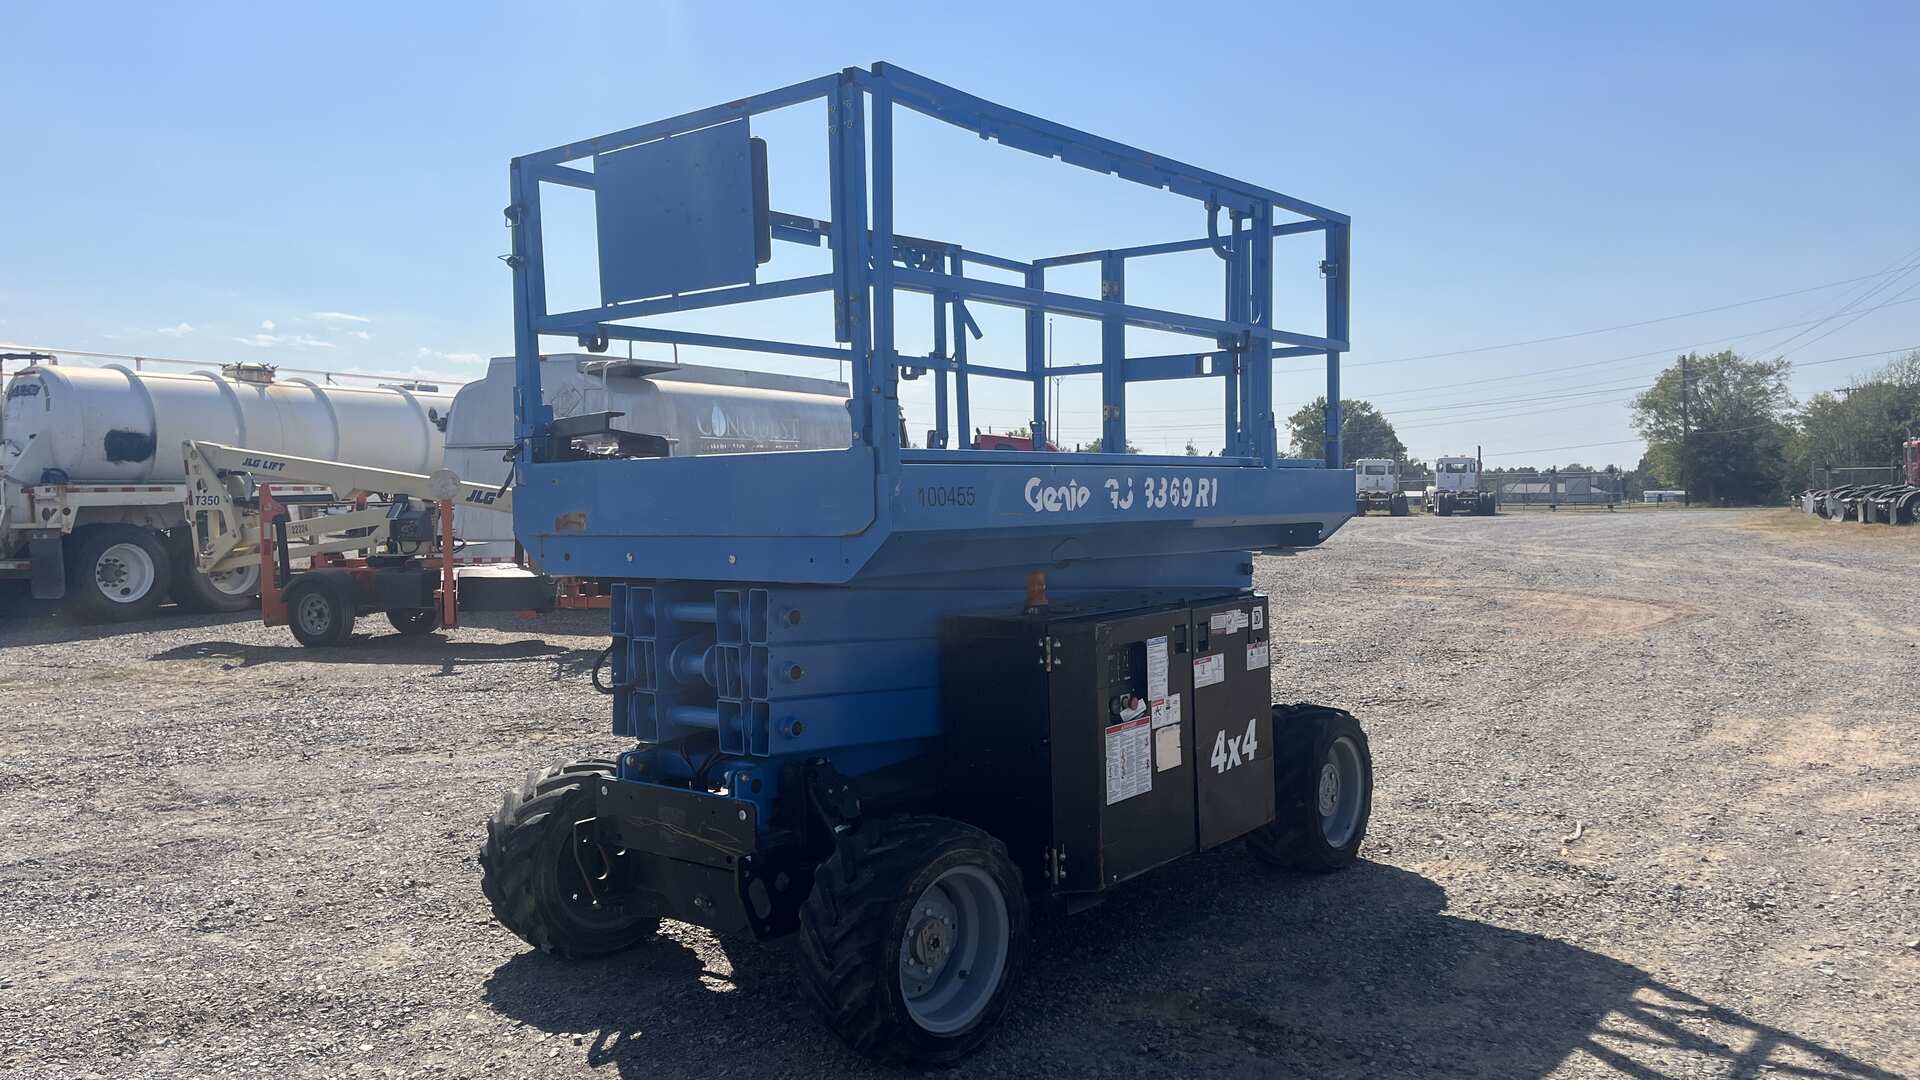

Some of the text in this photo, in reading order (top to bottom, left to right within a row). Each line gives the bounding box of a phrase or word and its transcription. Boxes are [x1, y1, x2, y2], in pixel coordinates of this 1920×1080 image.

[242, 457, 285, 471] JLG LIFT
[195, 495, 220, 506] T350
[465, 489, 497, 505] JLG
[1024, 476, 1091, 512] Genie
[1210, 718, 1258, 774] 4x4
